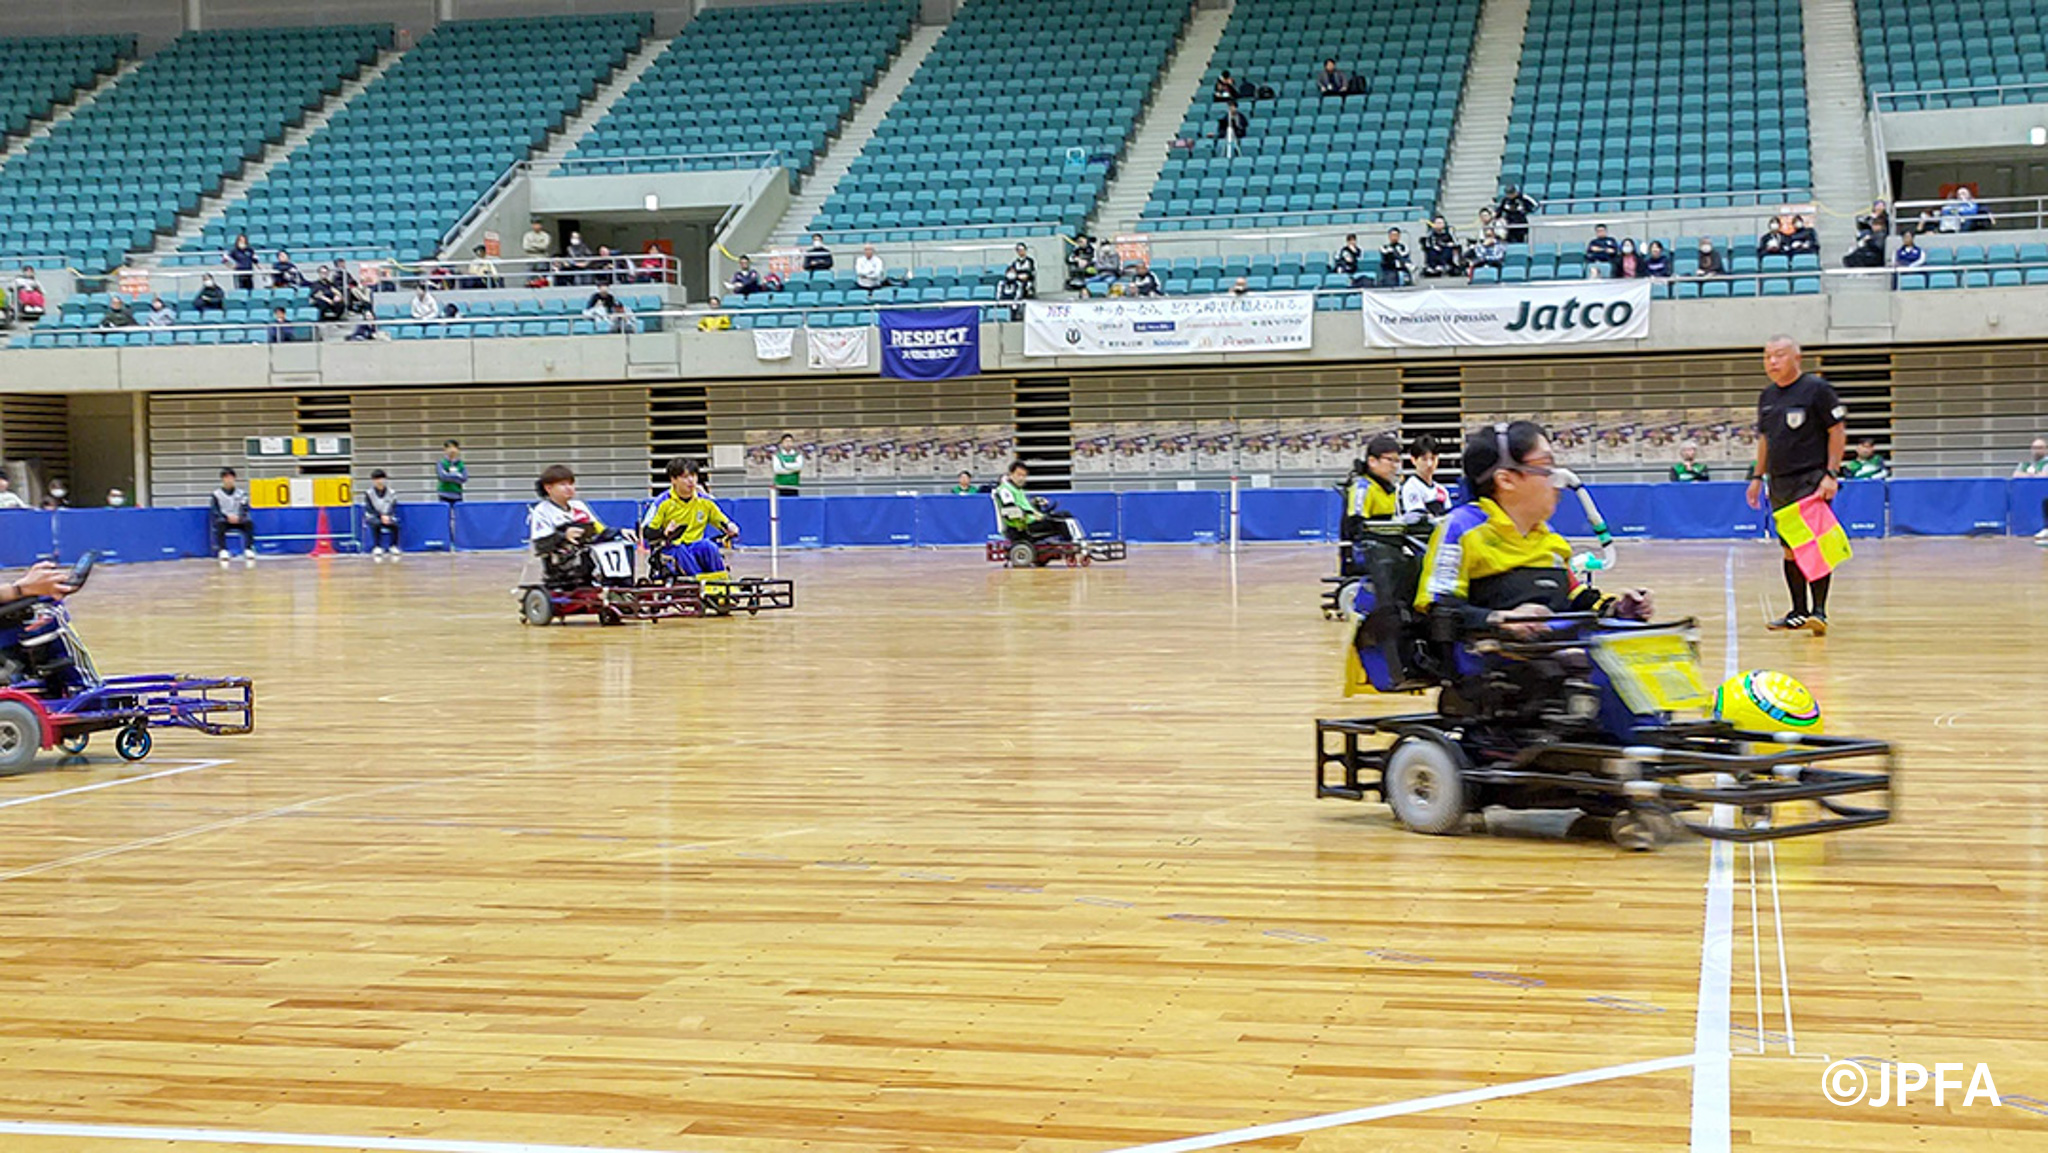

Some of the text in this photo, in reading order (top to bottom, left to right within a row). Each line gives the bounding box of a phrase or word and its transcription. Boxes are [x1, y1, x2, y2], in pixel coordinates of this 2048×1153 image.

[1378, 314, 1397, 325] The
[1399, 313, 1441, 324] mission
[1504, 296, 1634, 332] Jatco
[890, 327, 969, 348] RESPECT
[277, 484, 289, 505] 0
[339, 483, 350, 503] 0
[604, 550, 622, 572] 17
